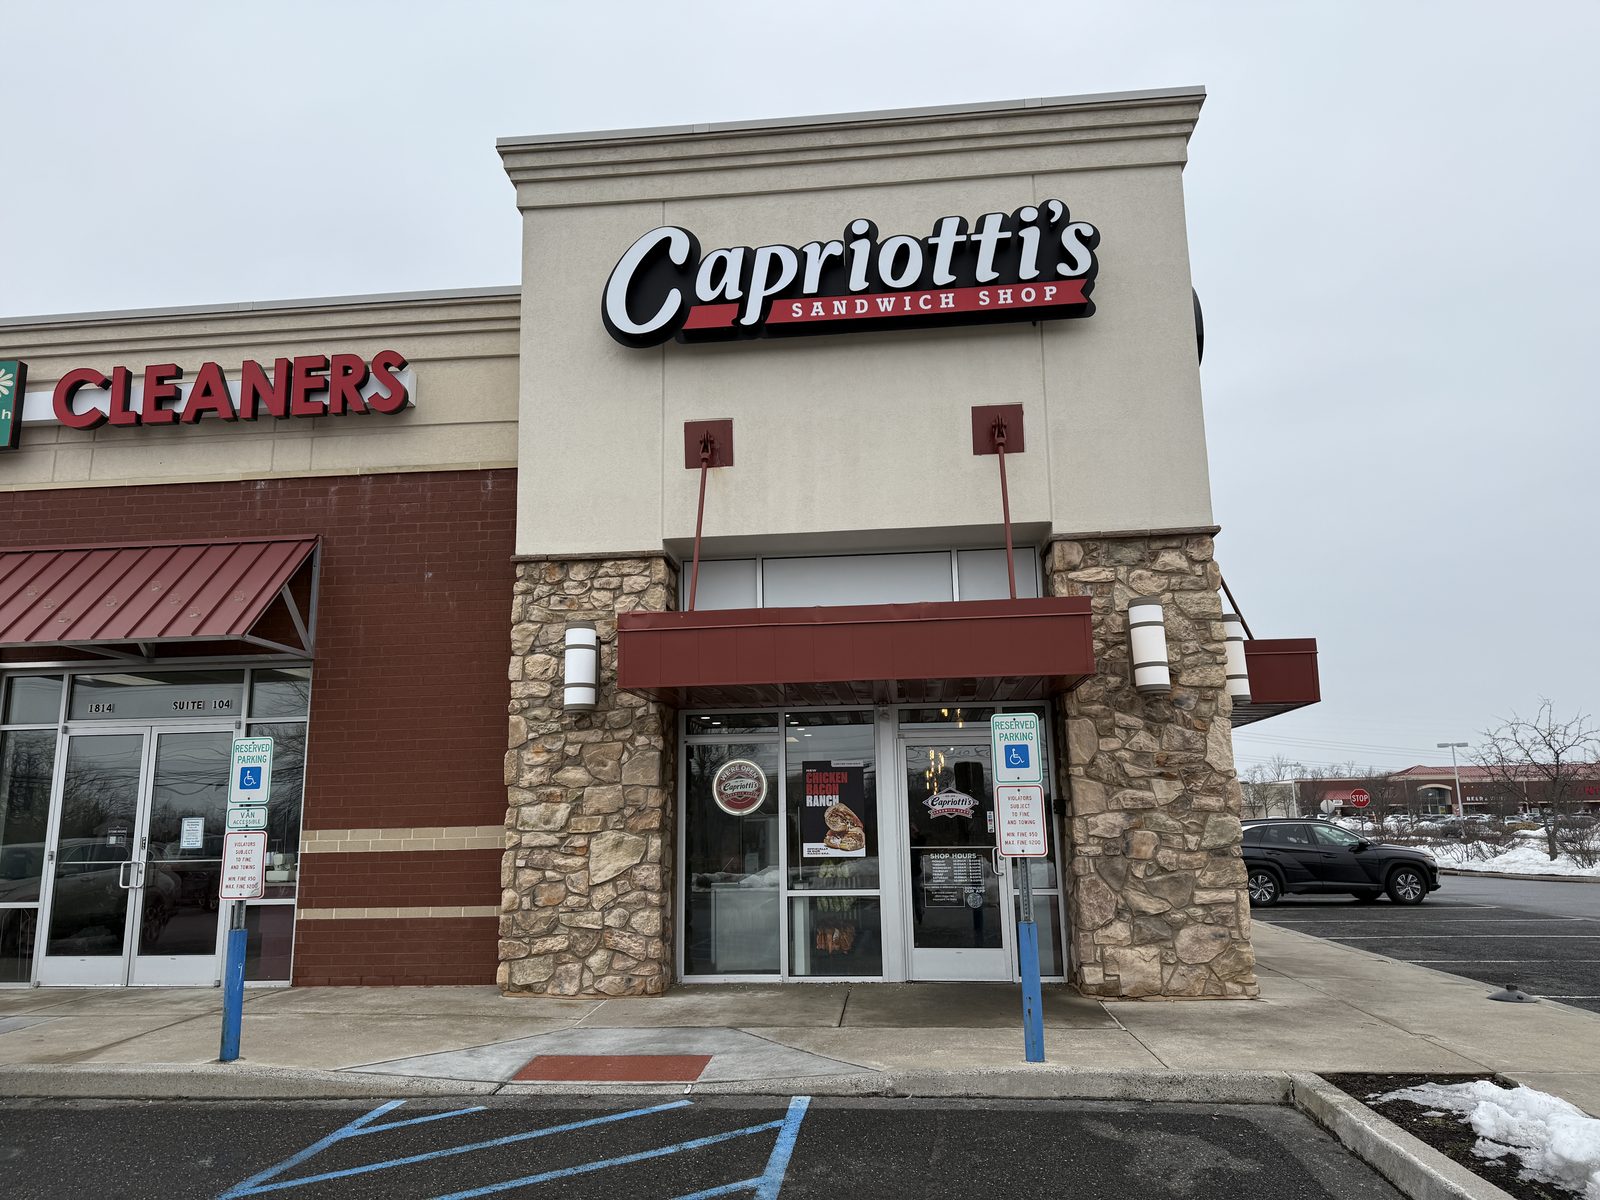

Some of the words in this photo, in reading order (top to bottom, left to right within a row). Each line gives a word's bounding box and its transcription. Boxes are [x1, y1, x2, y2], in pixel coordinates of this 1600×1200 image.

[605, 199, 1095, 334] Capriotti's
[791, 292, 955, 318] SANDWICH
[979, 285, 1059, 307] SHOP
[52, 350, 409, 430] CLEANERS
[88, 703, 113, 713] 1814
[172, 700, 203, 711] SUITE
[212, 699, 231, 709] 104
[994, 720, 1035, 730] RESERVED
[999, 732, 1034, 741] PARKING
[235, 743, 270, 753] RESERVED
[237, 755, 267, 764] PARKING
[720, 764, 740, 781] WE'RE
[741, 765, 759, 779] OPEN
[806, 772, 848, 783] CHICKEN
[723, 781, 758, 792] Capriotti's
[806, 783, 839, 795] BACON
[806, 794, 839, 807] RANCH
[930, 796, 972, 808] Capriotti's
[1351, 794, 1369, 802] STOP
